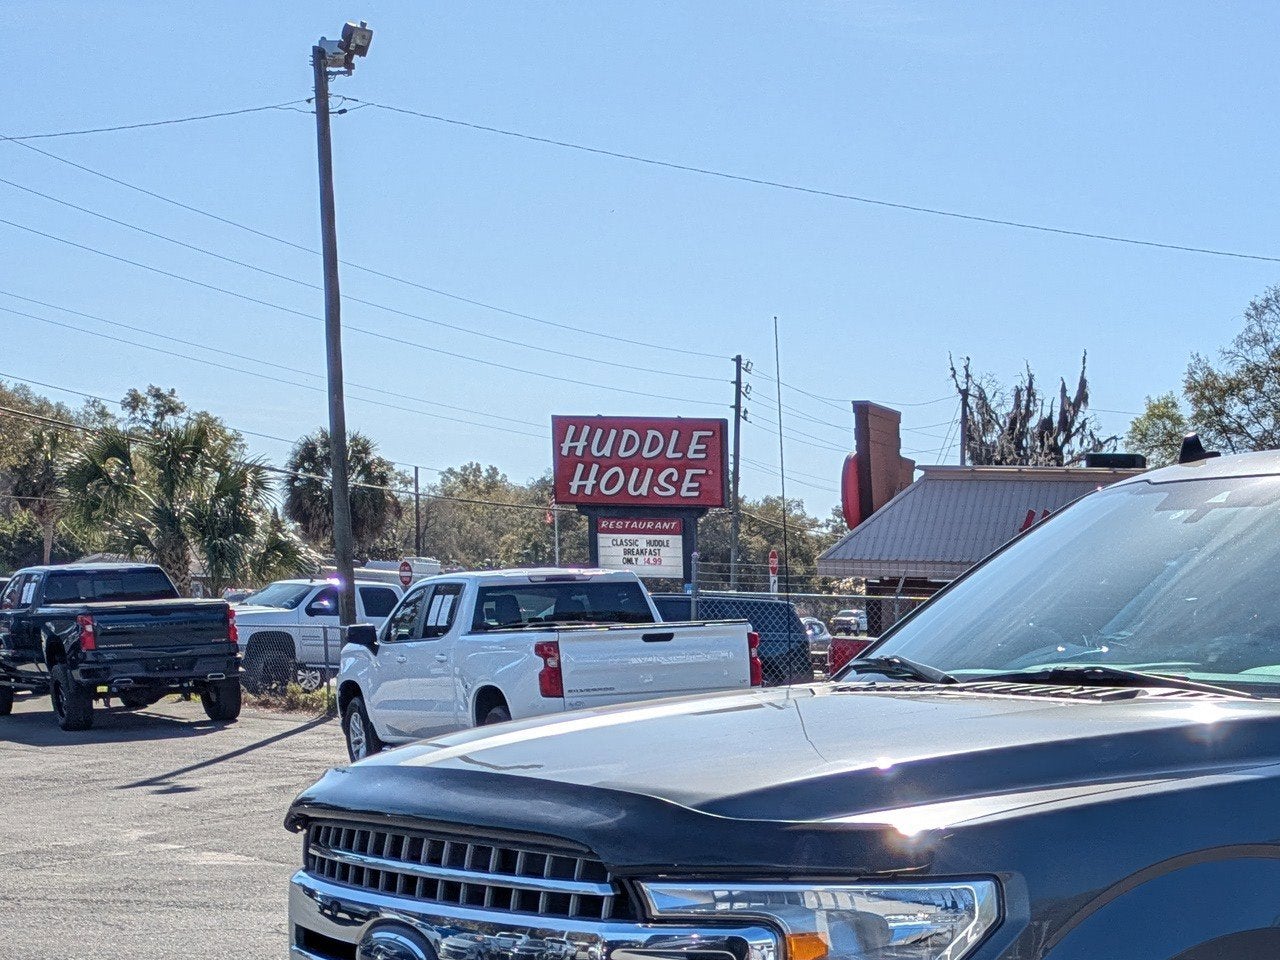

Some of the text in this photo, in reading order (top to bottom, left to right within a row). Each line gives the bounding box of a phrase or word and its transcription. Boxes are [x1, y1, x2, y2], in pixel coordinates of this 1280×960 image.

[560, 424, 713, 459] HUDDLE
[569, 463, 706, 497] HOUSE
[601, 520, 677, 530] RESTAURANT
[611, 538, 670, 548] CLASSIC HUDDLE
[623, 548, 661, 556] BREAKFAST
[622, 556, 639, 565] ONLY
